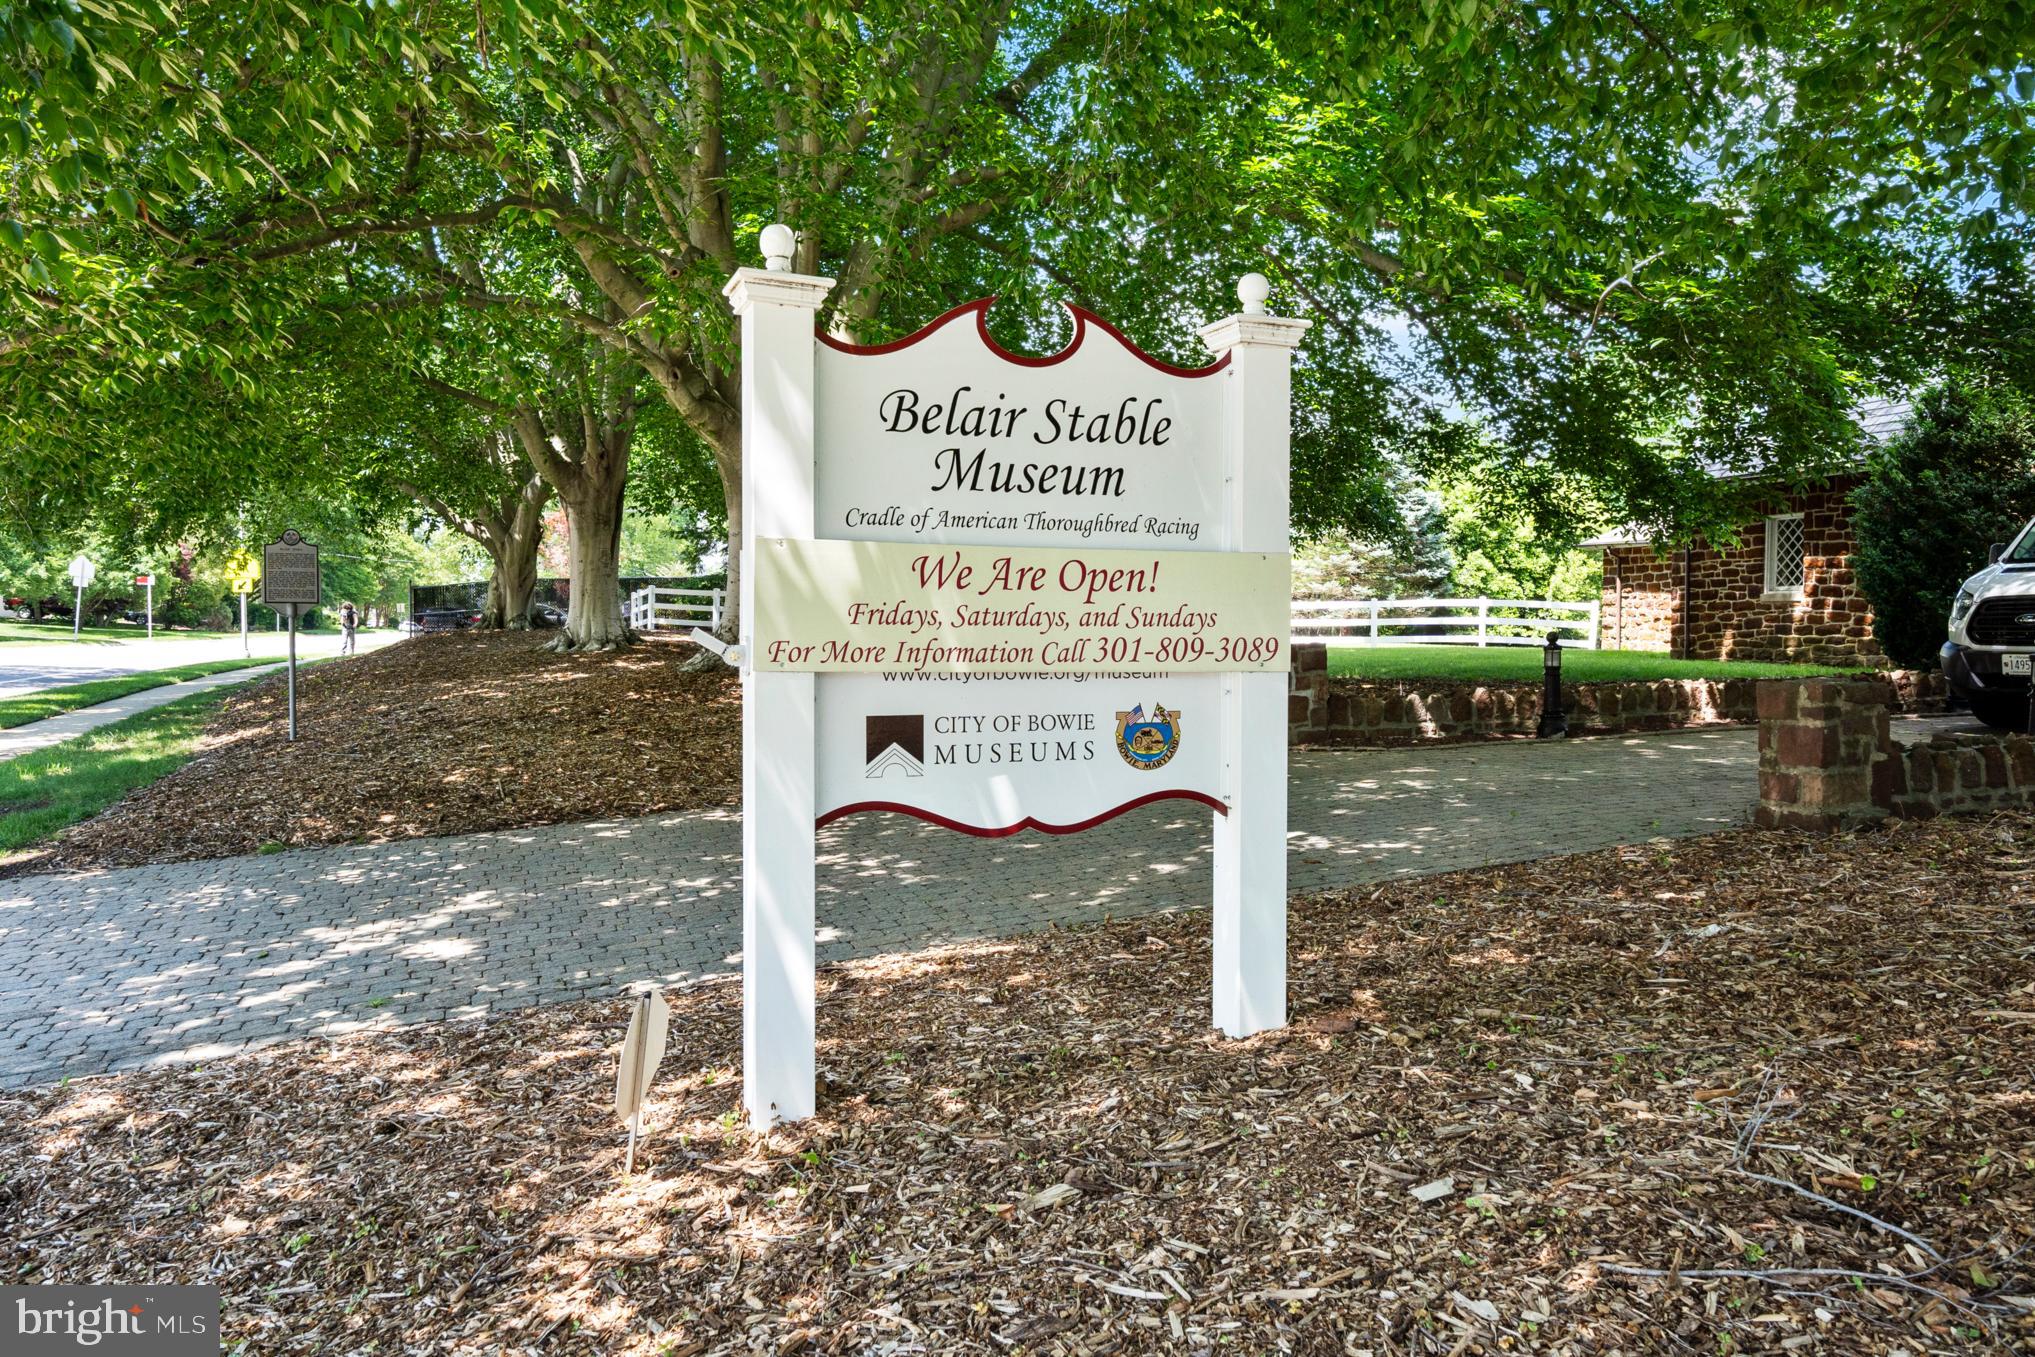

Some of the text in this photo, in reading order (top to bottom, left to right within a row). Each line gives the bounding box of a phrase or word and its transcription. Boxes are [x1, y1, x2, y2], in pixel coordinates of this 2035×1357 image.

[880, 386, 1171, 446] Belair Stable
[931, 448, 1125, 497] Museum
[845, 506, 1200, 541] Cradle of American Thoroughbred Racing
[911, 551, 1160, 605] We Are Open!
[847, 600, 1217, 636] Fridays, Saturdays, and Sundays
[768, 636, 1279, 670] For More Information Call 301-809-3089
[934, 713, 1096, 734] CITY OF BOWIE
[933, 741, 1096, 765] MUSEUMS
[1143, 739, 1179, 770] MARYLAND
